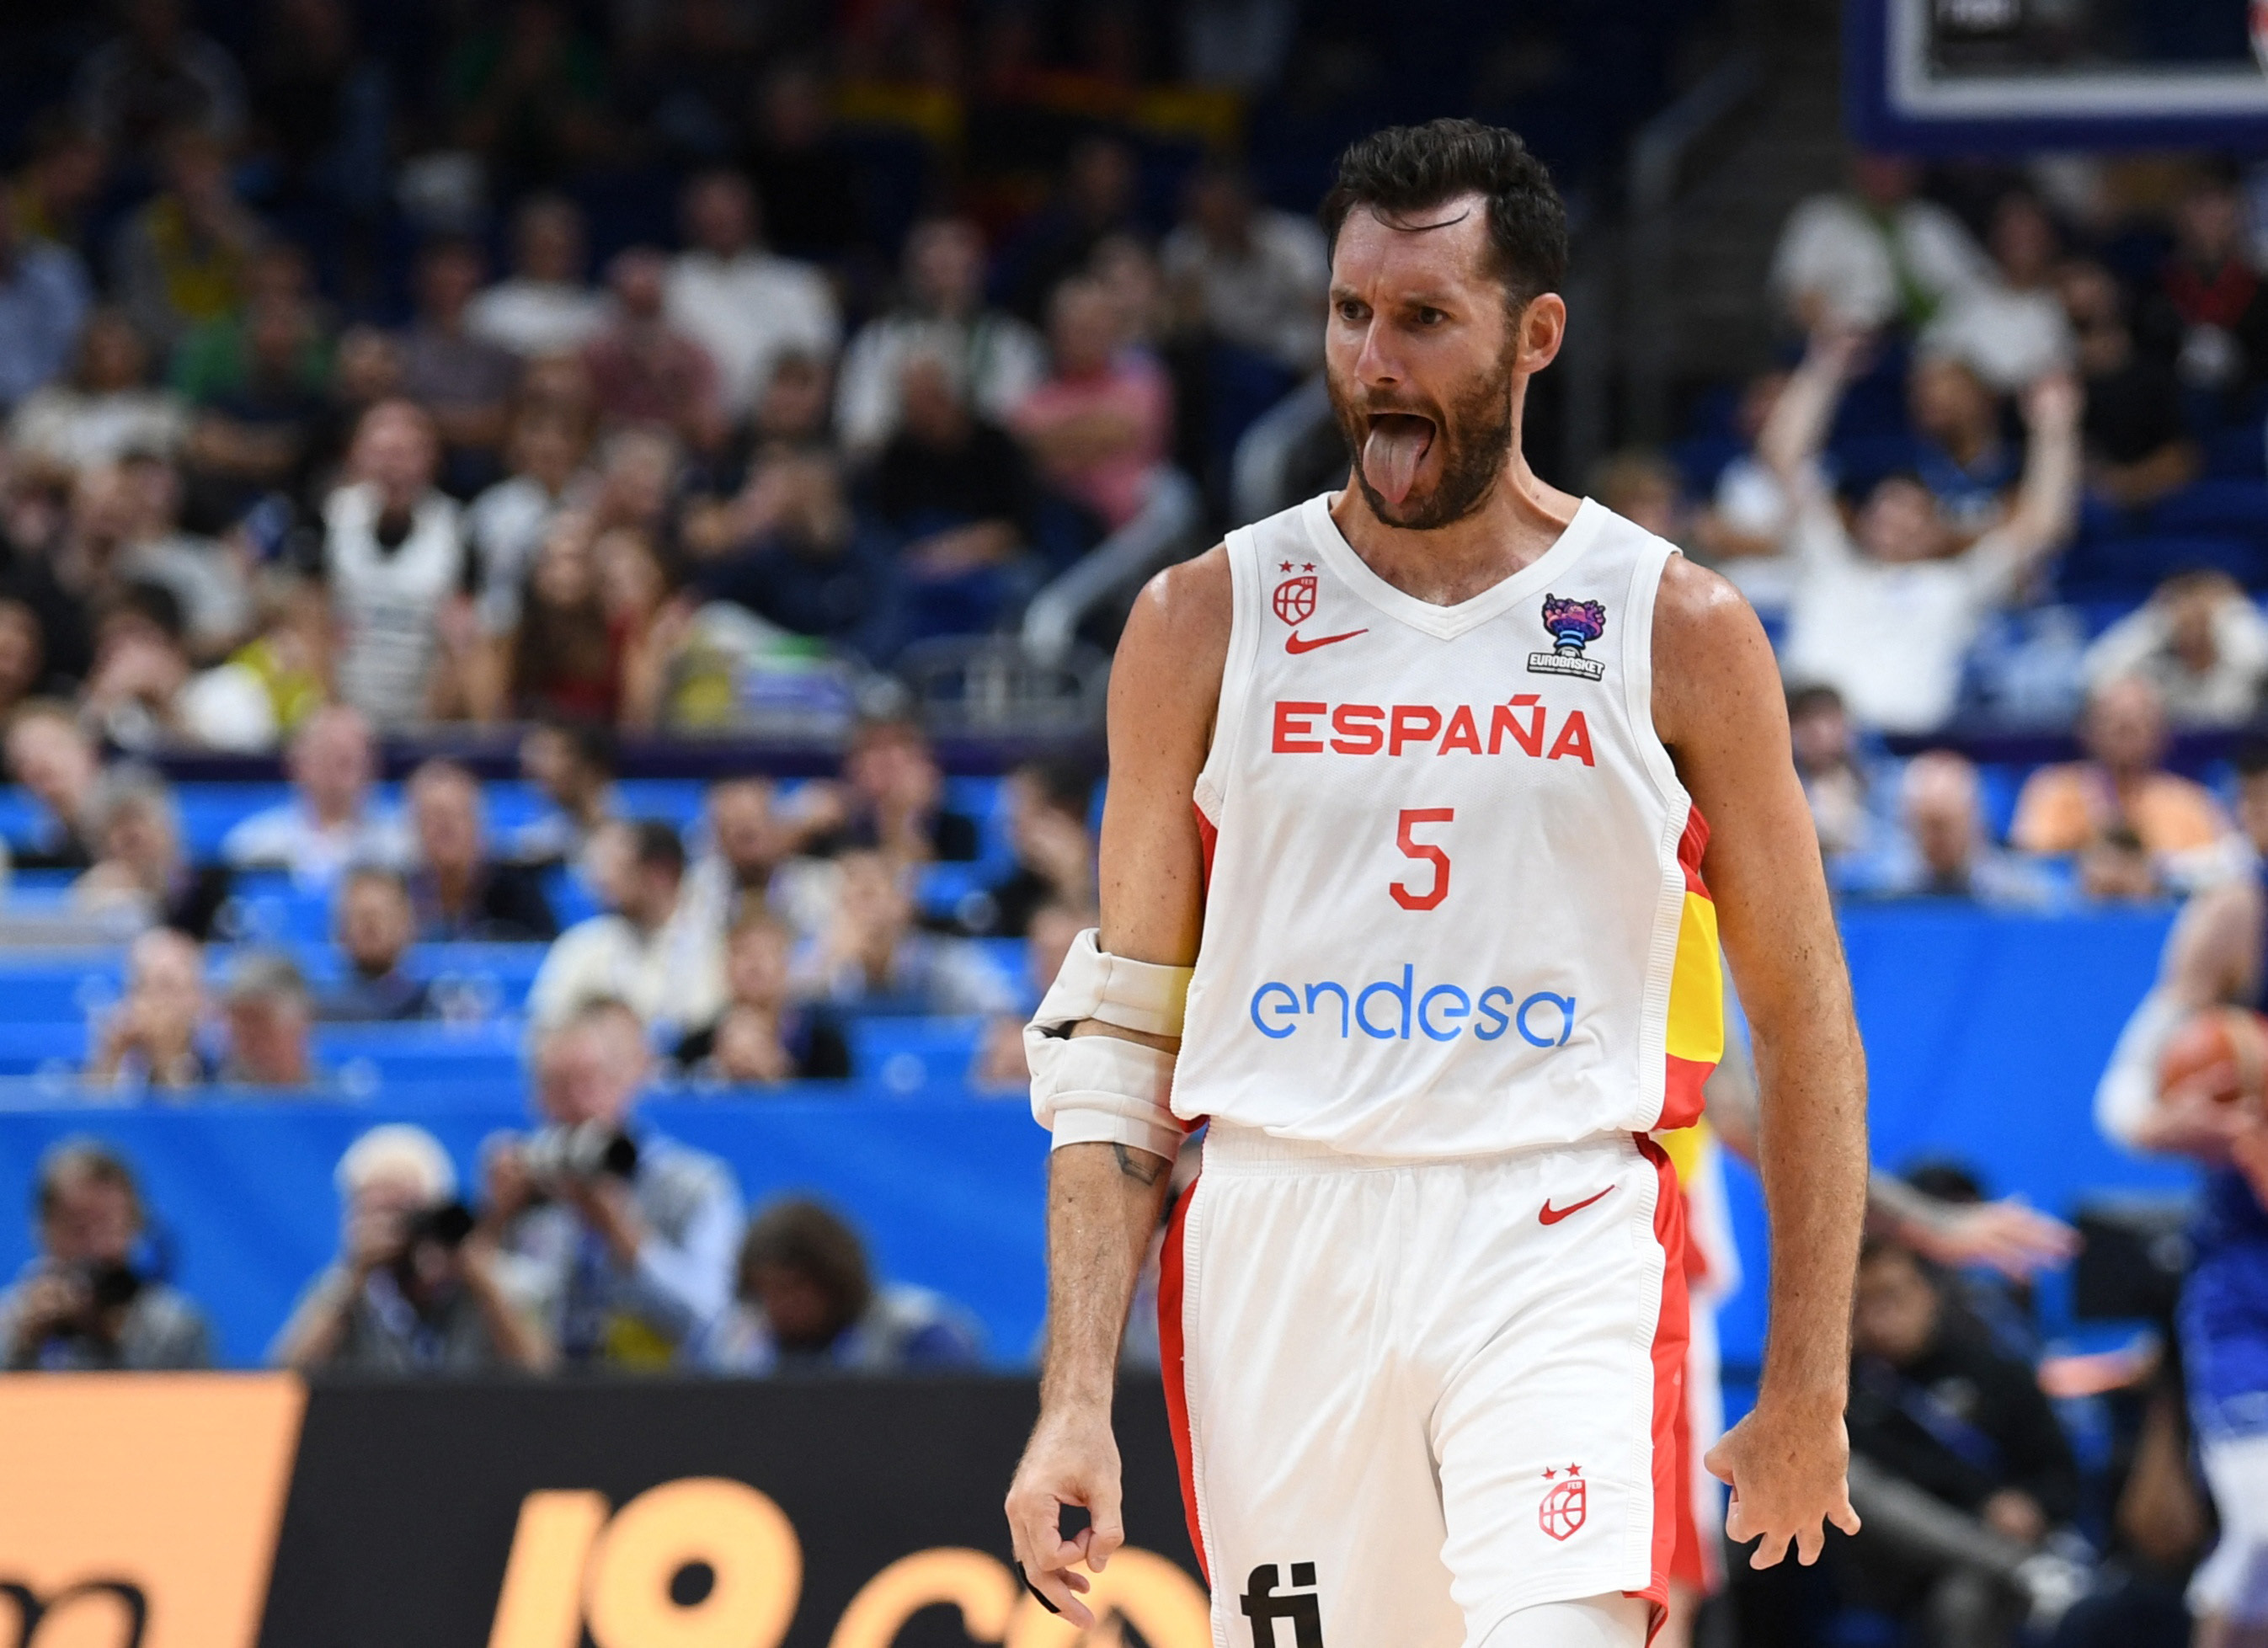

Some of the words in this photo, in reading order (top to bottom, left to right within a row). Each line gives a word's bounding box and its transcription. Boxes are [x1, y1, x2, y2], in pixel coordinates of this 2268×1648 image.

[1529, 653, 1604, 675] EUROBASKET
[1273, 694, 1595, 767] ESPAÑA
[1390, 808, 1454, 911] 5
[1251, 963, 1576, 1048] endesa
